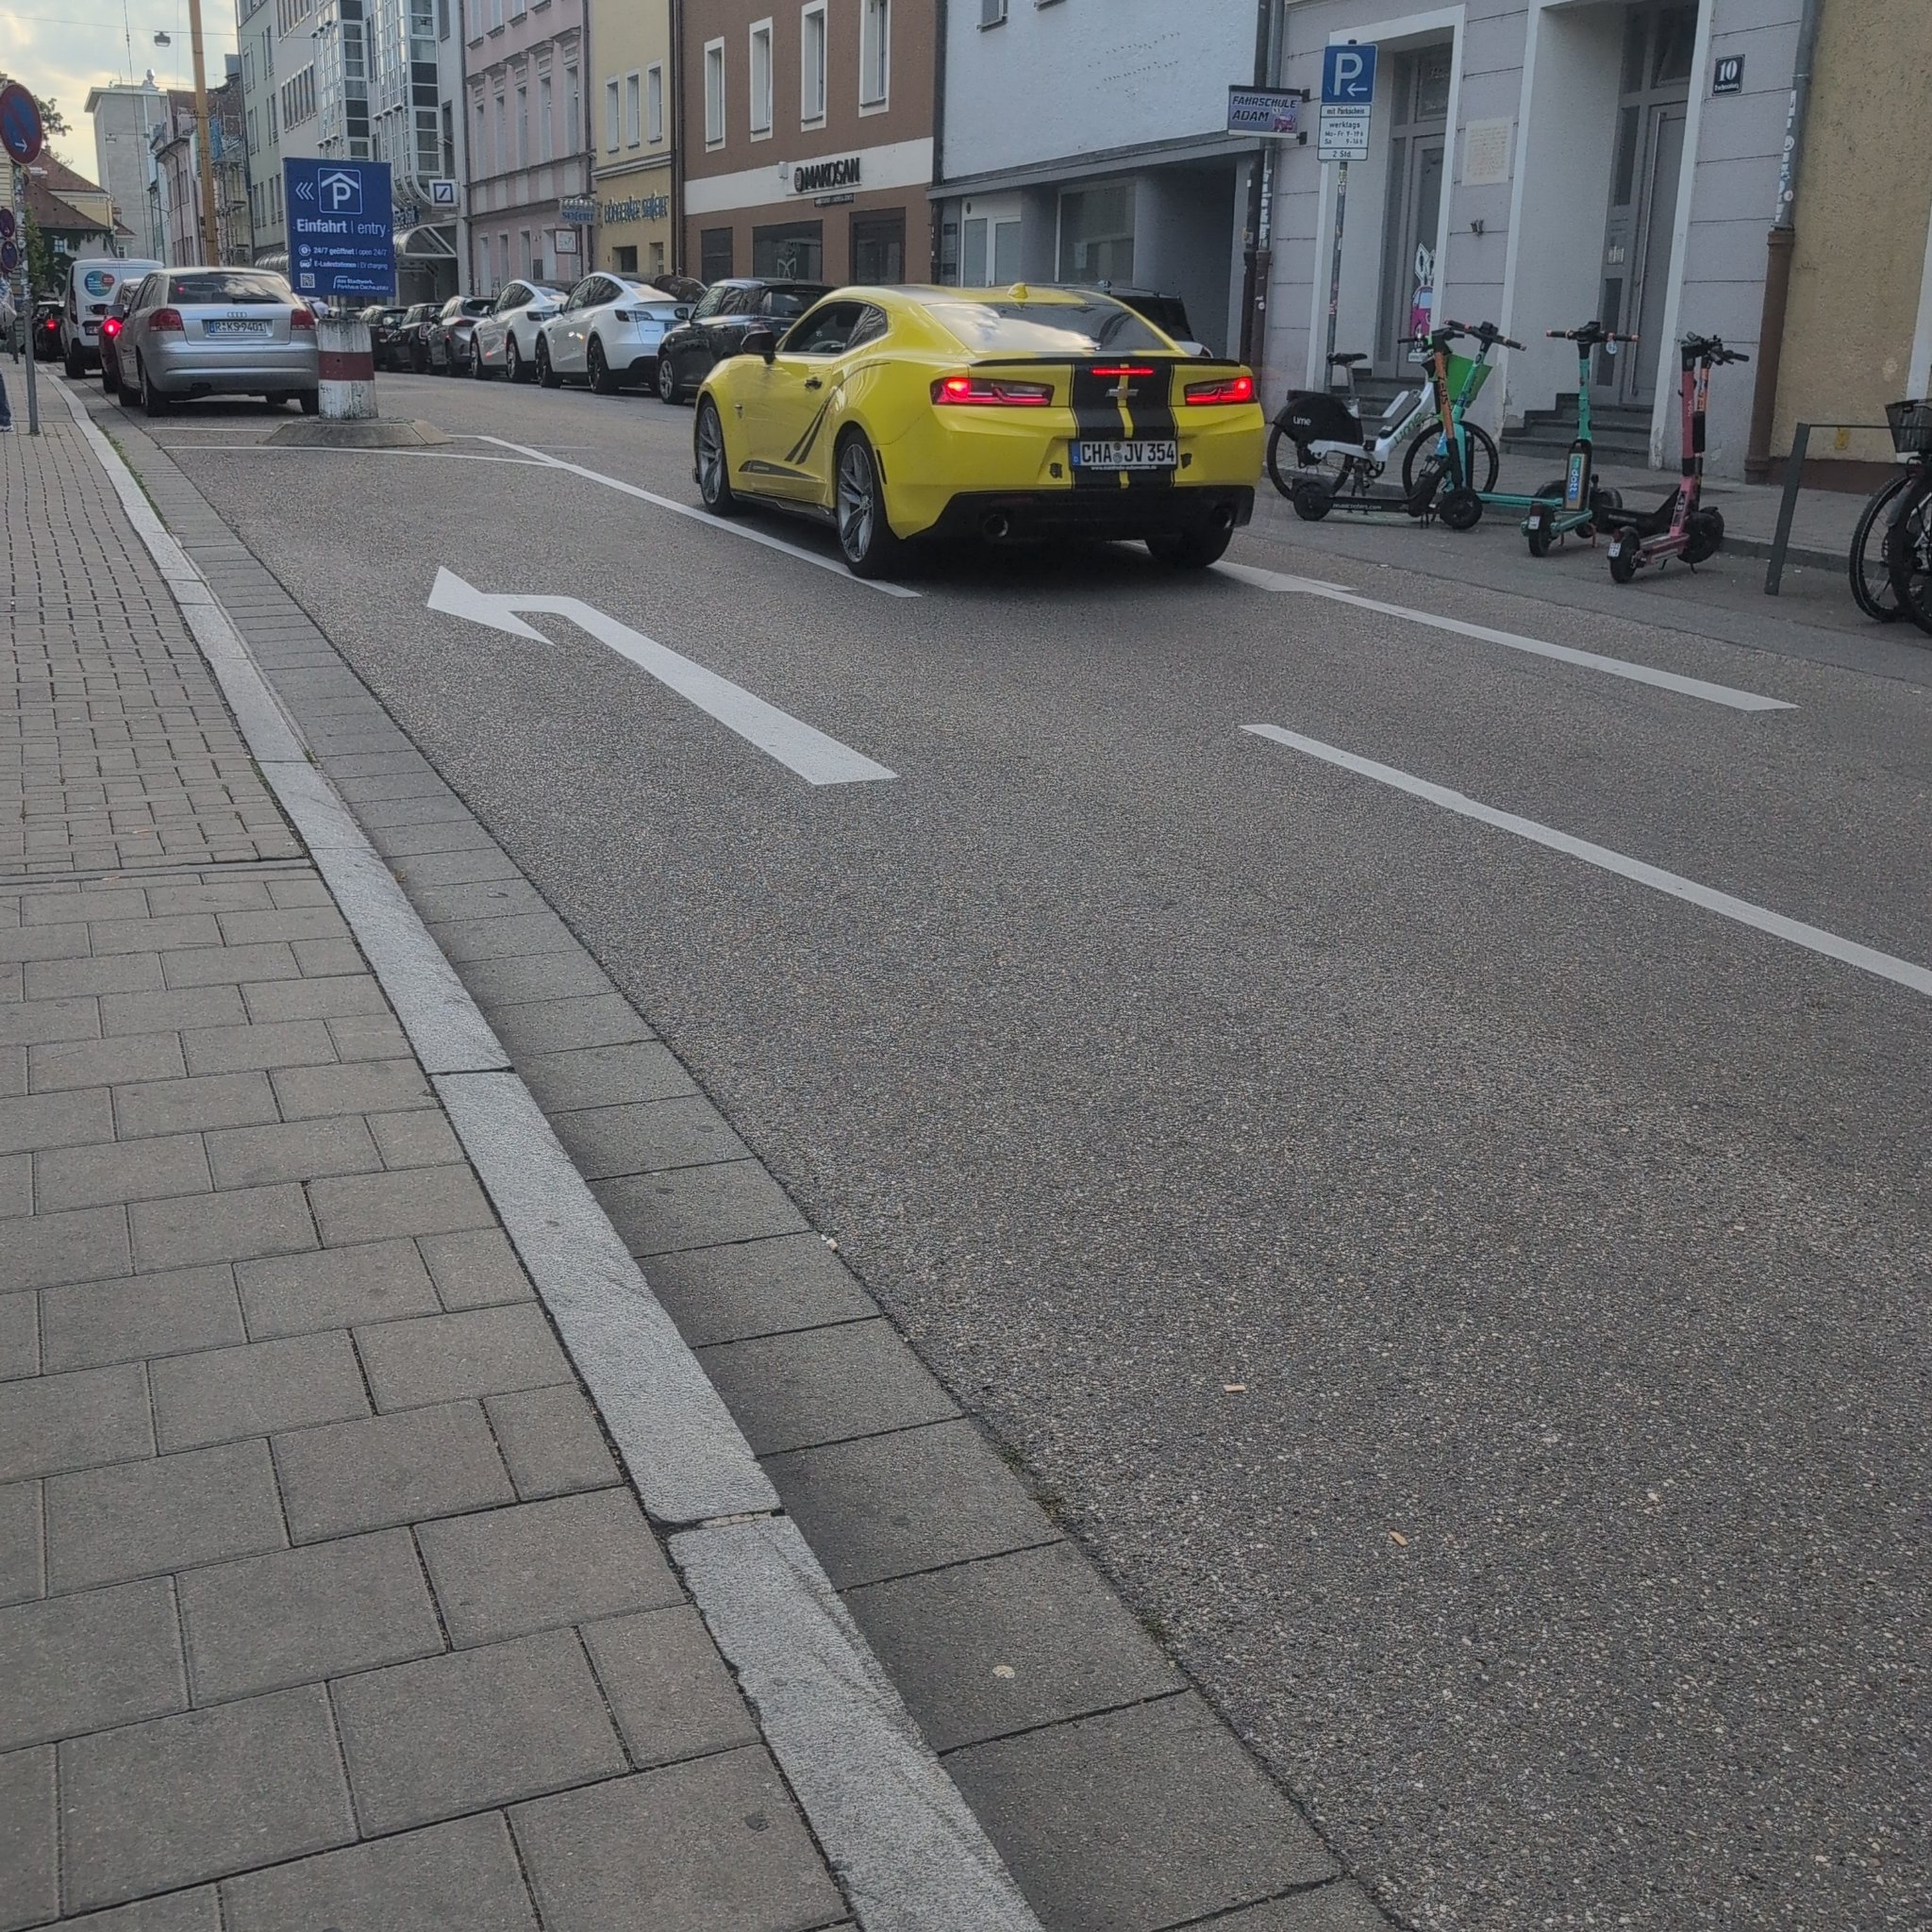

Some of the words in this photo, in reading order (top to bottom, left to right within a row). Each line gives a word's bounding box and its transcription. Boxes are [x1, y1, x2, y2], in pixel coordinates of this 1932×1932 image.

[1334, 53, 1363, 95] P
[1719, 60, 1737, 81] 10
[1233, 96, 1297, 108] FAHRSCHULE
[1232, 110, 1269, 122] ADAM
[333, 182, 351, 209] P
[296, 219, 347, 233] Einfahrt
[358, 222, 386, 238] entry
[215, 322, 221, 331] R
[1082, 443, 1112, 463] CHA
[1124, 443, 1143, 463] JV
[1147, 443, 1174, 462] 354
